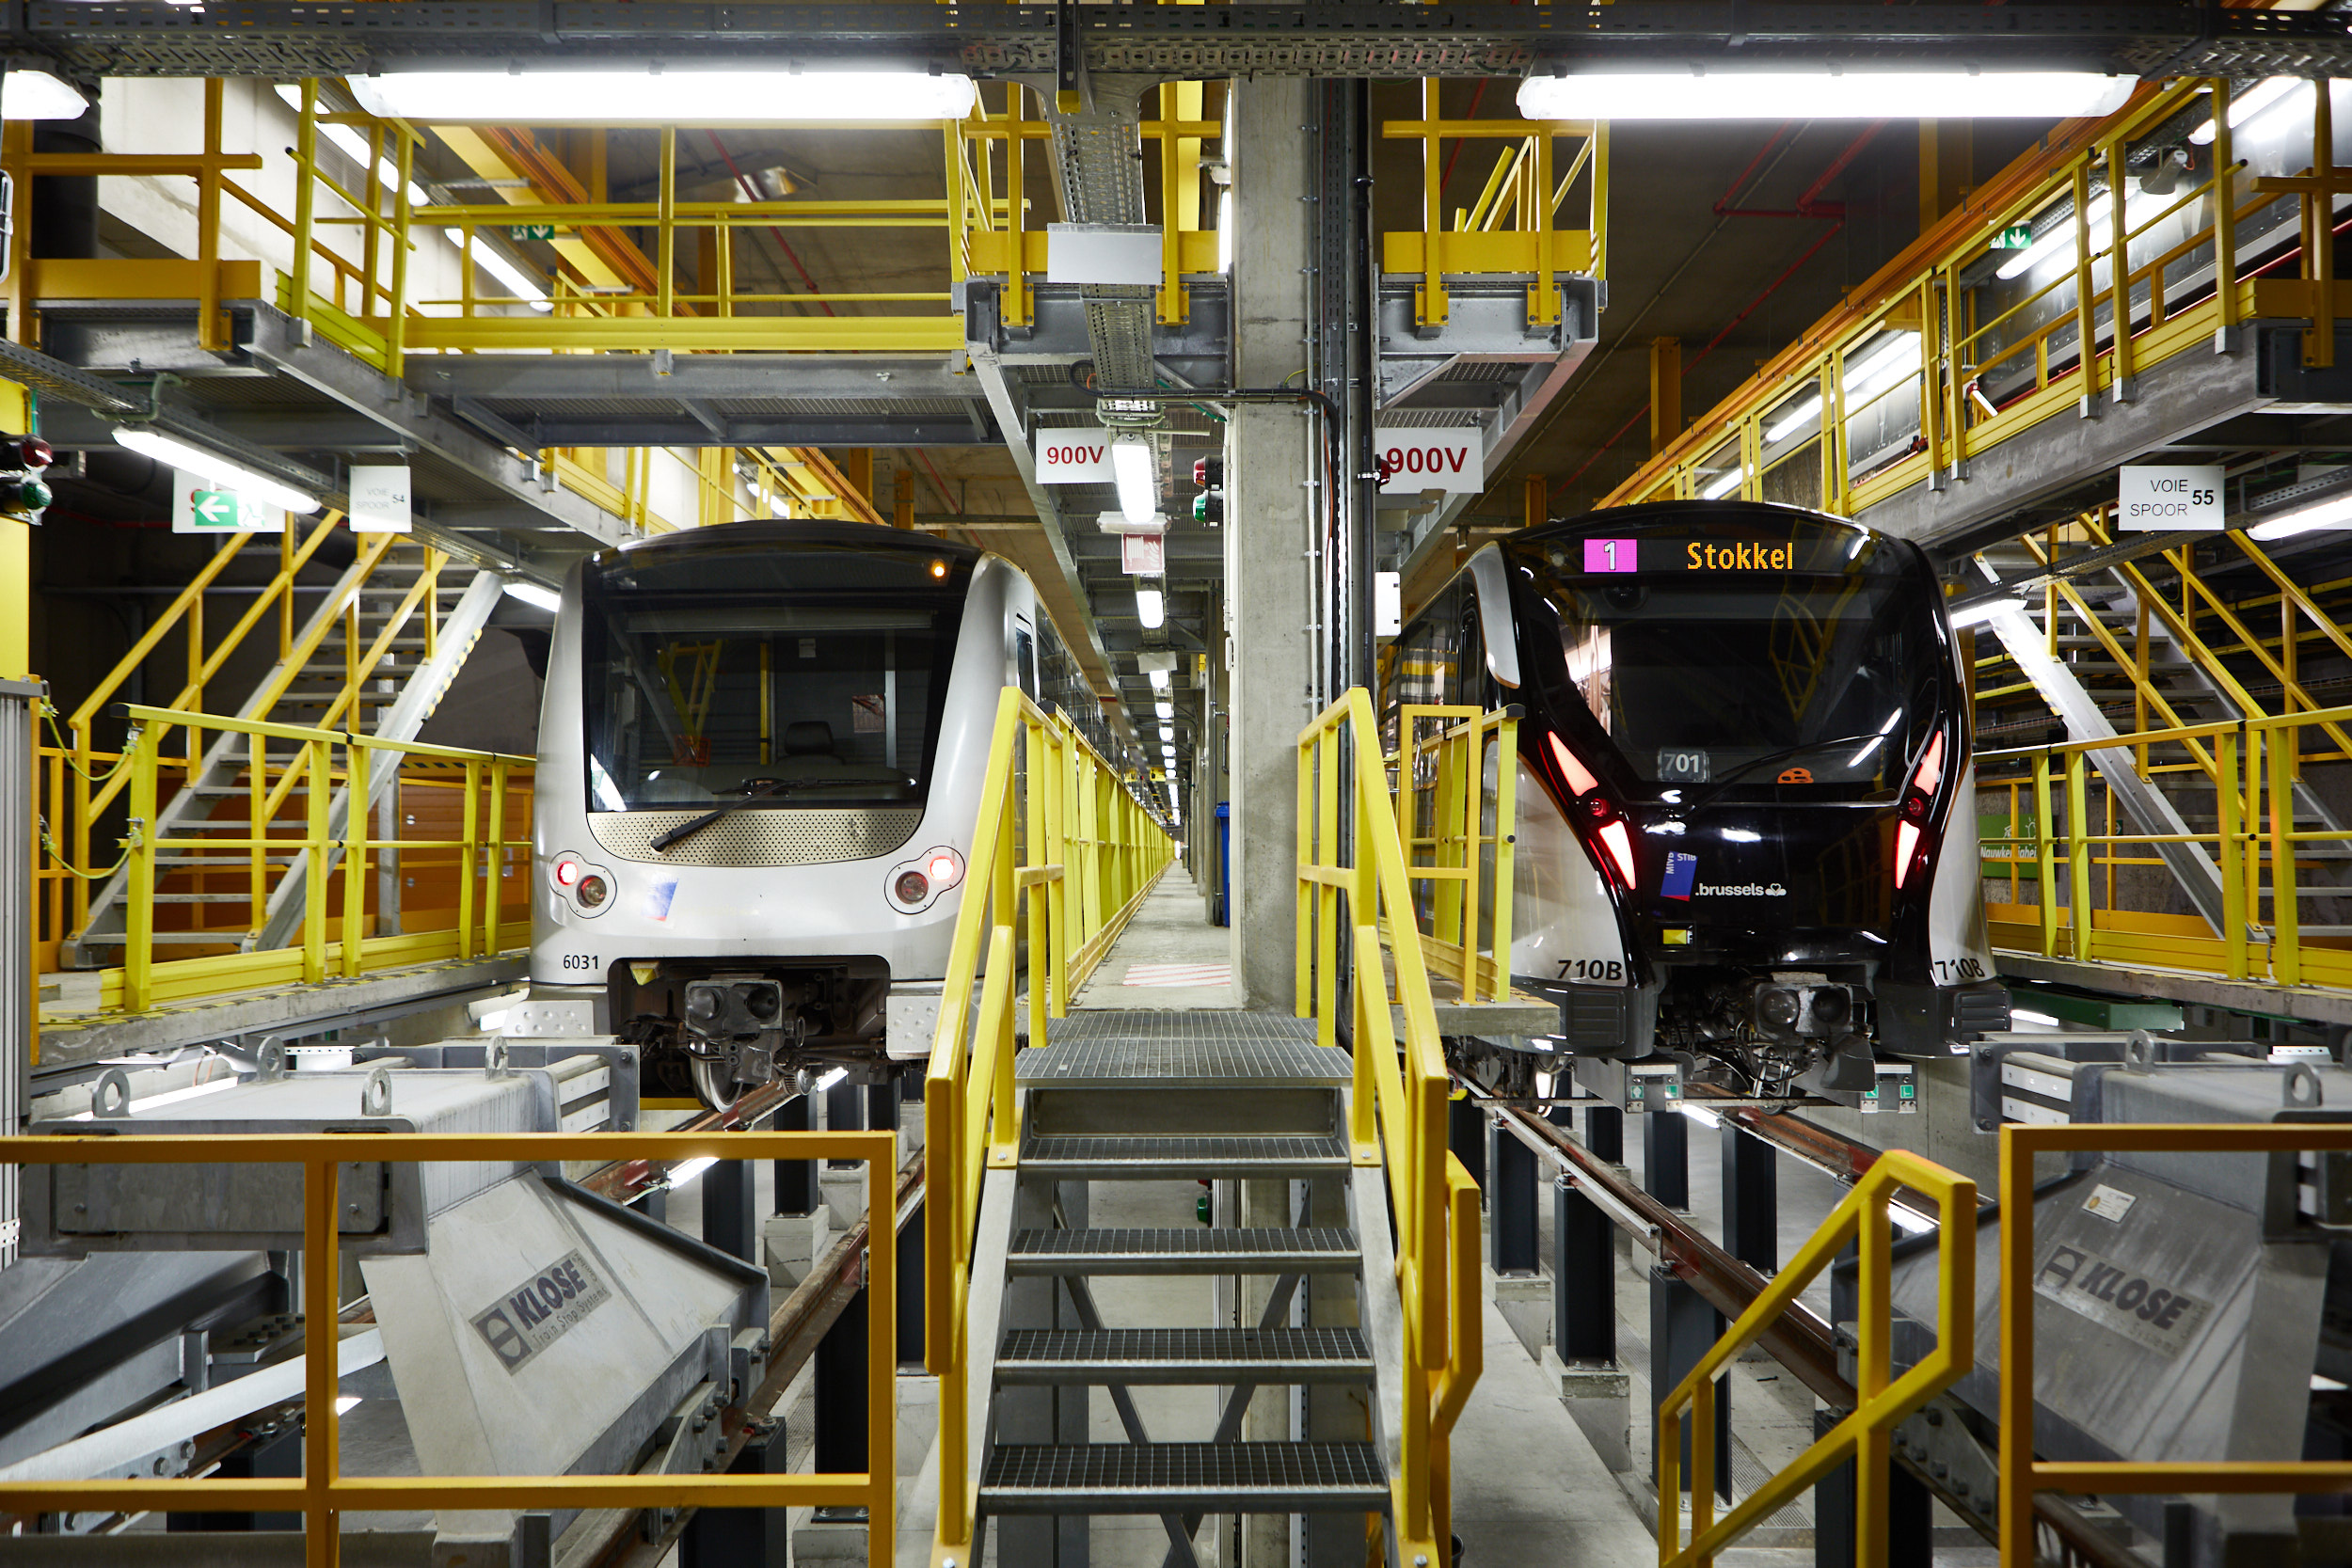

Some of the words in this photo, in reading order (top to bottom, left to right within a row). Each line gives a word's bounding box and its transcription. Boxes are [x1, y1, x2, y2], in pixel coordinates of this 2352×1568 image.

[1046, 446, 1104, 465] 900V
[1386, 447, 1468, 473] 900V
[365, 487, 389, 497] VOIE
[2150, 479, 2188, 492] VOIE
[355, 500, 389, 510] SPOOR
[2192, 489, 2214, 505] 55
[2130, 503, 2188, 516] SPOOR
[1603, 541, 1616, 571] 1
[1687, 542, 1793, 570] Stokkel
[1663, 753, 1700, 773] 701
[1665, 851, 1675, 875] MIVB
[1677, 852, 1697, 862] STIB
[563, 955, 599, 970] 6031
[1557, 959, 1623, 981] 710B
[1934, 958, 1985, 980] 710B
[508, 1259, 588, 1332] KLOSE
[2077, 1261, 2192, 1331] KLOSE
[532, 1323, 559, 1347] Train
[556, 1307, 580, 1329] Stop
[576, 1286, 608, 1314] Systems
